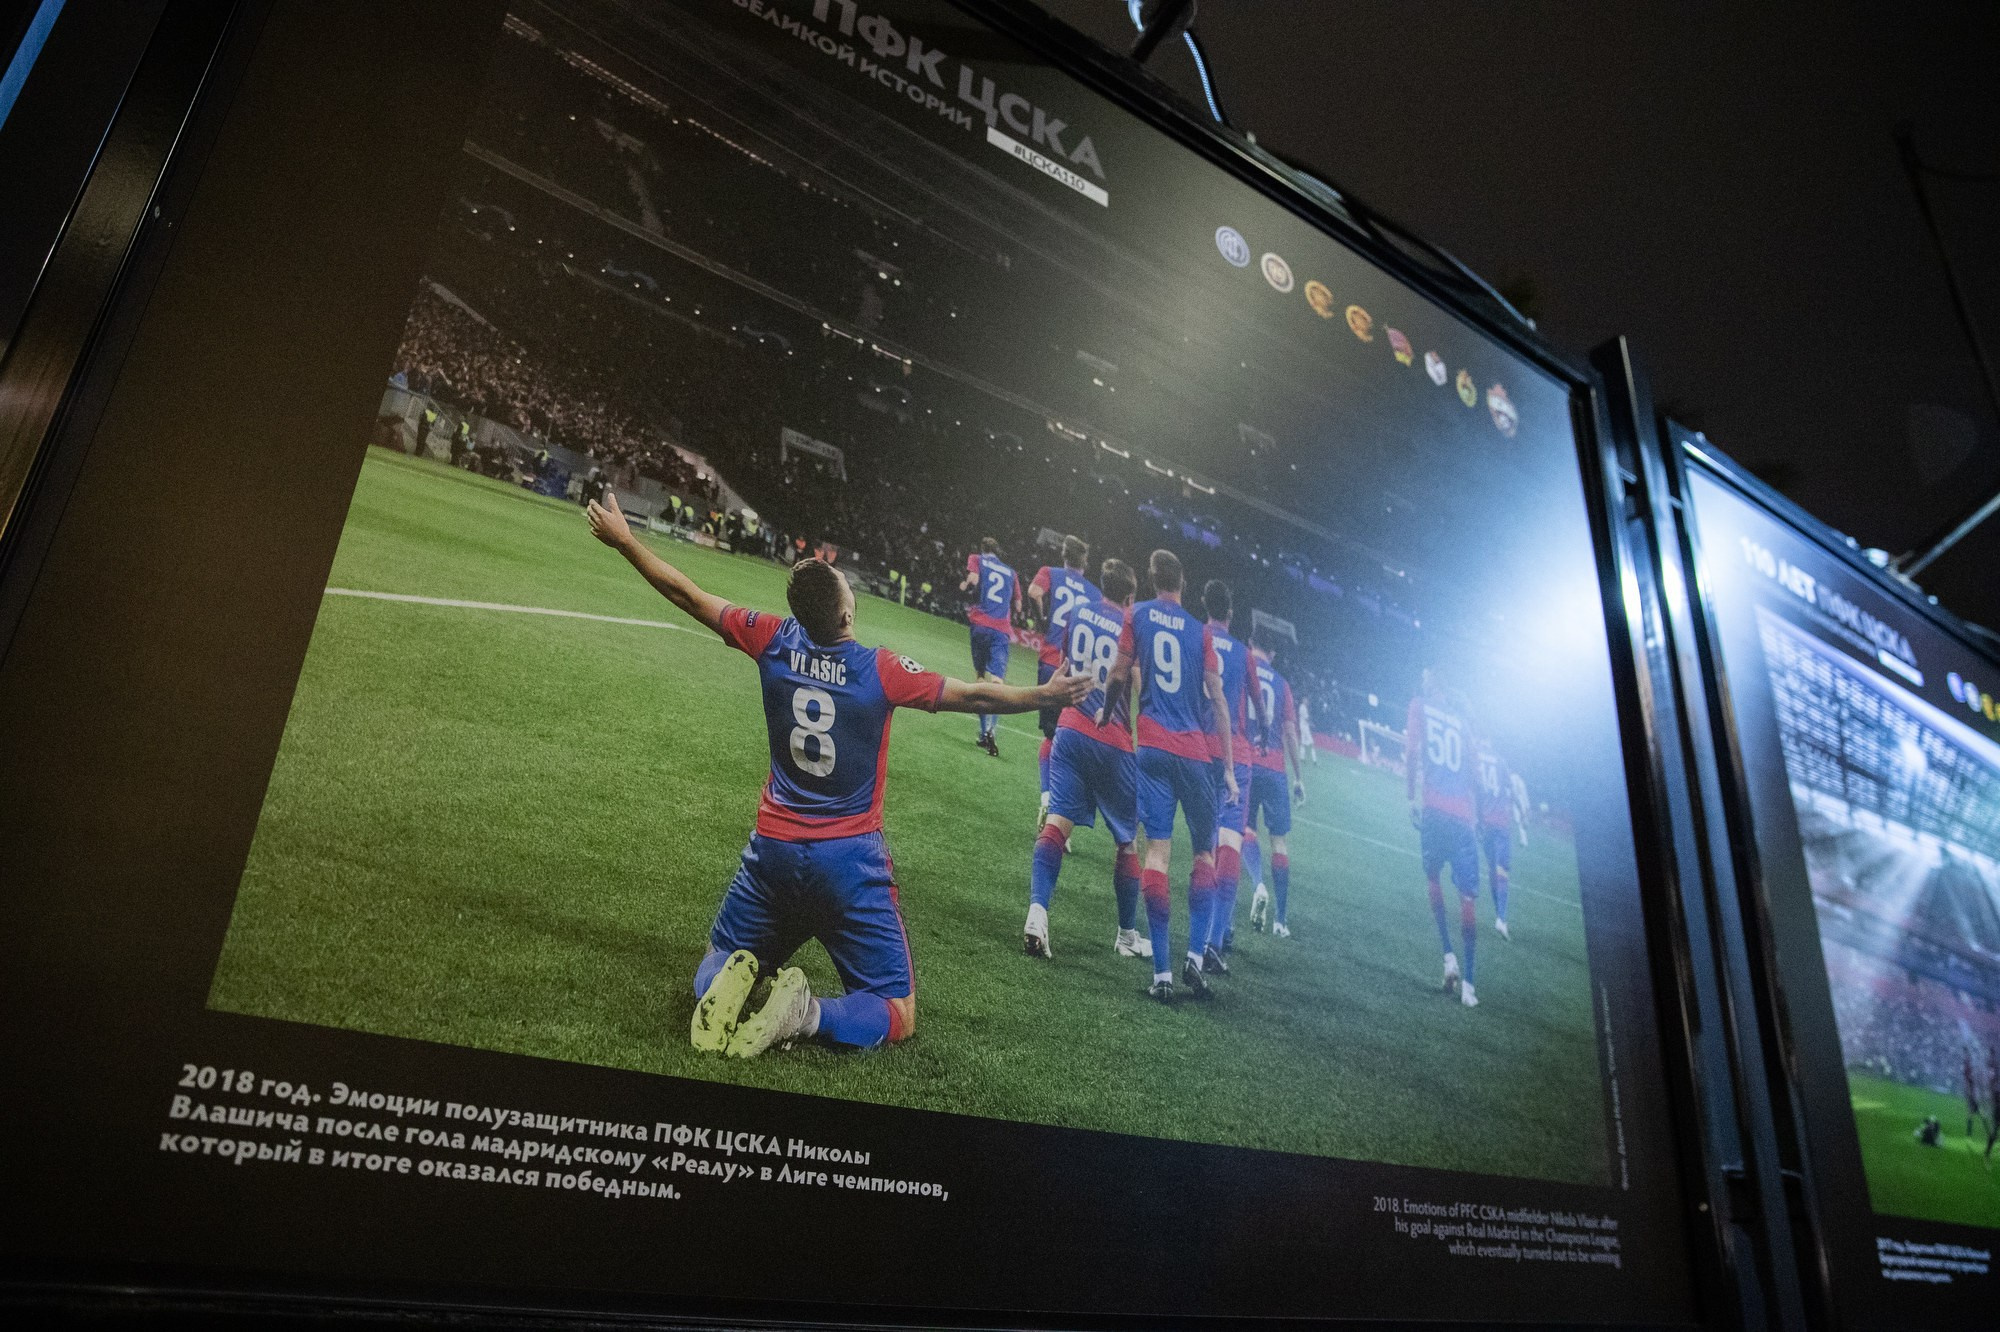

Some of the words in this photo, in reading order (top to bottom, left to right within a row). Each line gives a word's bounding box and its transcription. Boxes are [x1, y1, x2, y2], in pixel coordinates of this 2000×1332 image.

[811, 0, 947, 90] ПФК
[957, 63, 1106, 180] ЦСКА
[859, 57, 972, 132] ИСТОРИИ
[1014, 145, 1087, 191] #ЦСКА110
[987, 571, 1005, 604] 2
[1149, 608, 1185, 631] CHALOV
[790, 649, 847, 686] VLAŠIĆ
[1071, 623, 1119, 687] 98
[1153, 631, 1182, 694] 9
[789, 686, 836, 777] 8
[1426, 717, 1461, 772] 50
[178, 1063, 255, 1094] 2018
[260, 1078, 322, 1107] год.
[329, 1082, 440, 1118] Эмоции
[445, 1101, 648, 1142] полузащитника
[654, 1121, 712, 1148] ПФК
[716, 1129, 782, 1157] ЦСКА
[787, 1138, 871, 1166] Николы
[160, 1132, 303, 1166] который
[308, 1147, 326, 1166] в
[331, 1150, 413, 1174] итоге
[417, 1160, 540, 1187] оказался
[545, 1171, 682, 1199] победным.
[169, 1094, 310, 1133] Влашича
[316, 1116, 401, 1142] после
[405, 1127, 466, 1150] гола
[471, 1134, 647, 1175] мадридскому
[651, 1151, 755, 1183] «Реалу»
[760, 1165, 773, 1181] в
[776, 1162, 829, 1187] Лиге
[833, 1174, 949, 1202] чемпионов,
[1373, 1196, 1402, 1214] 2018.
[1404, 1199, 1448, 1217] Emotions
[1449, 1202, 1460, 1217] of
[1461, 1204, 1479, 1220] PFC
[1480, 1205, 1506, 1221] CSKA
[1394, 1216, 1408, 1233] his
[1410, 1219, 1432, 1239] goal
[1433, 1221, 1465, 1240] against
[1466, 1222, 1486, 1238] Real
[1487, 1224, 1520, 1240] Madrid
[1448, 1240, 1476, 1256] which
